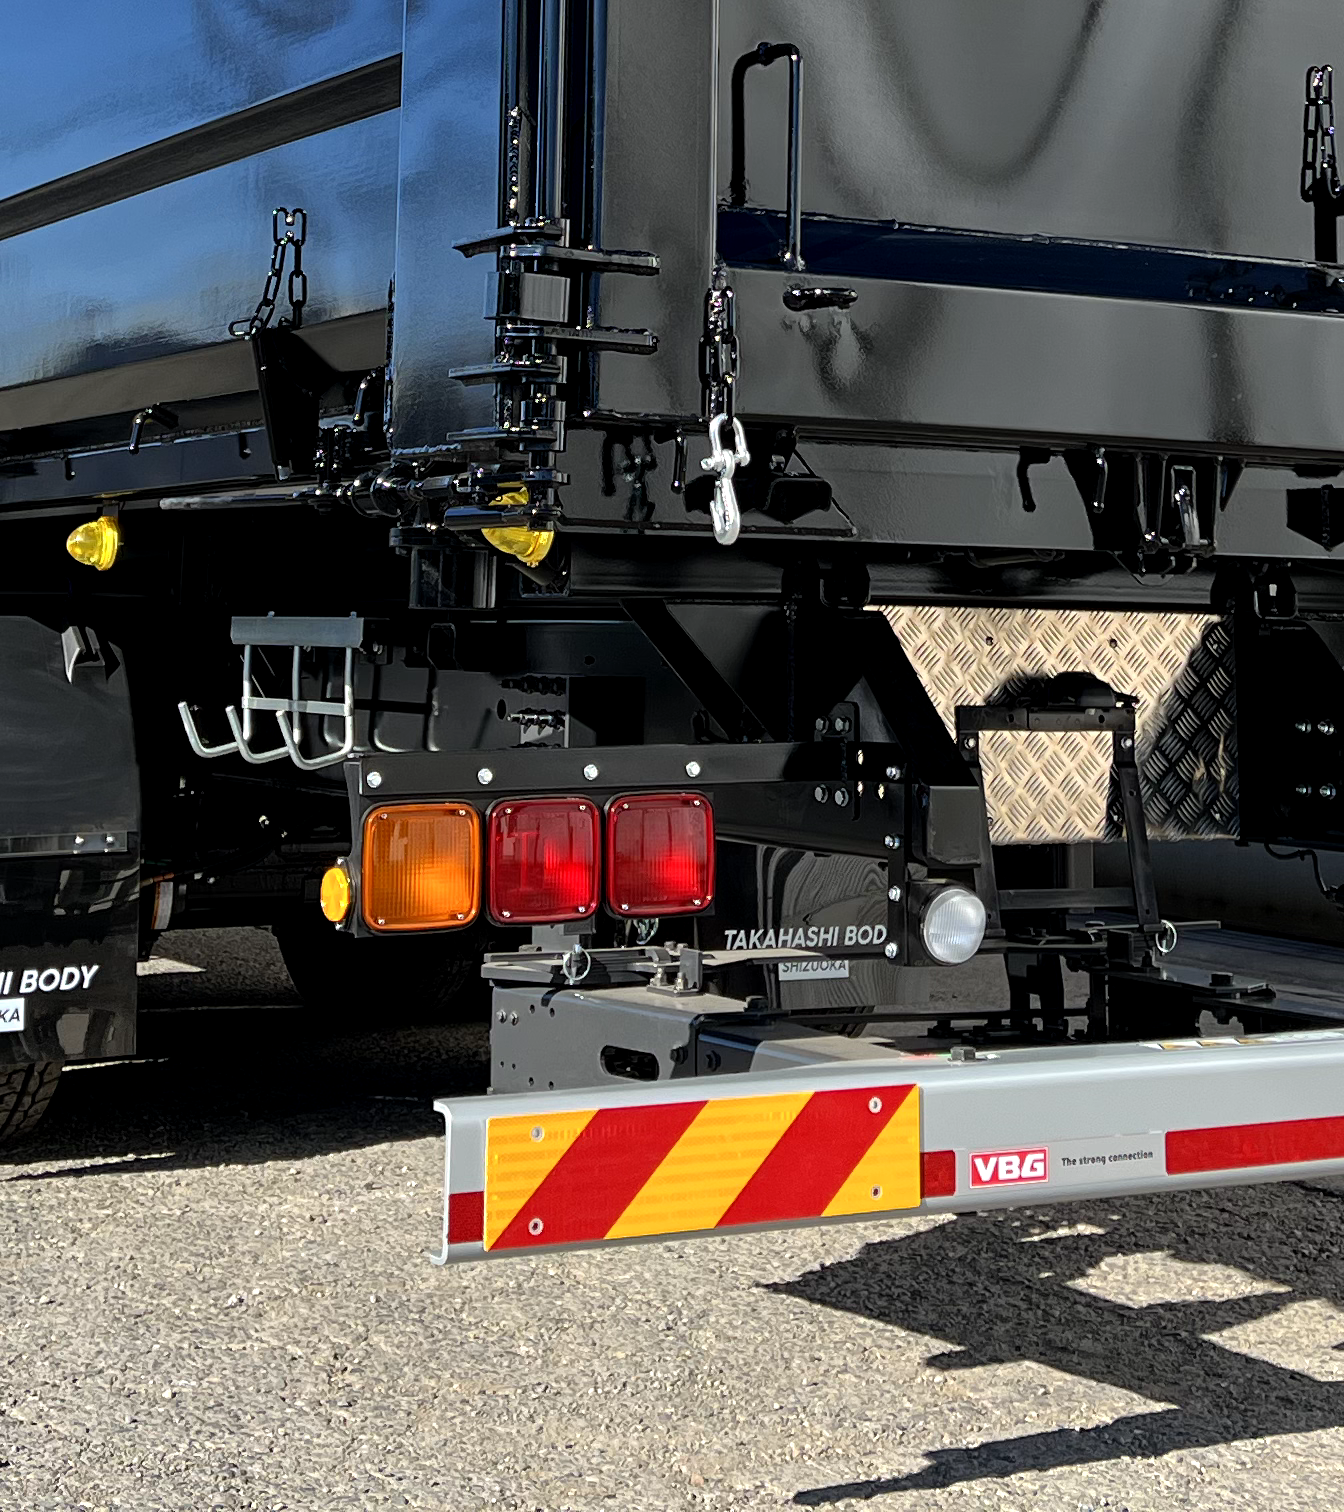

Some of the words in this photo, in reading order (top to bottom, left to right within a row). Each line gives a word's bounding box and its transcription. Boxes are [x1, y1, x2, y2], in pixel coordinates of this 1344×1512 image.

[724, 926, 840, 950] TAKAHASHI
[844, 924, 888, 946] BOD
[18, 964, 99, 994] BODY
[781, 960, 847, 974] SHIZUOKA
[973, 1152, 1046, 1182] VBG
[1061, 1156, 1077, 1167] The
[1079, 1154, 1106, 1166] strong
[1108, 1150, 1154, 1163] connection
